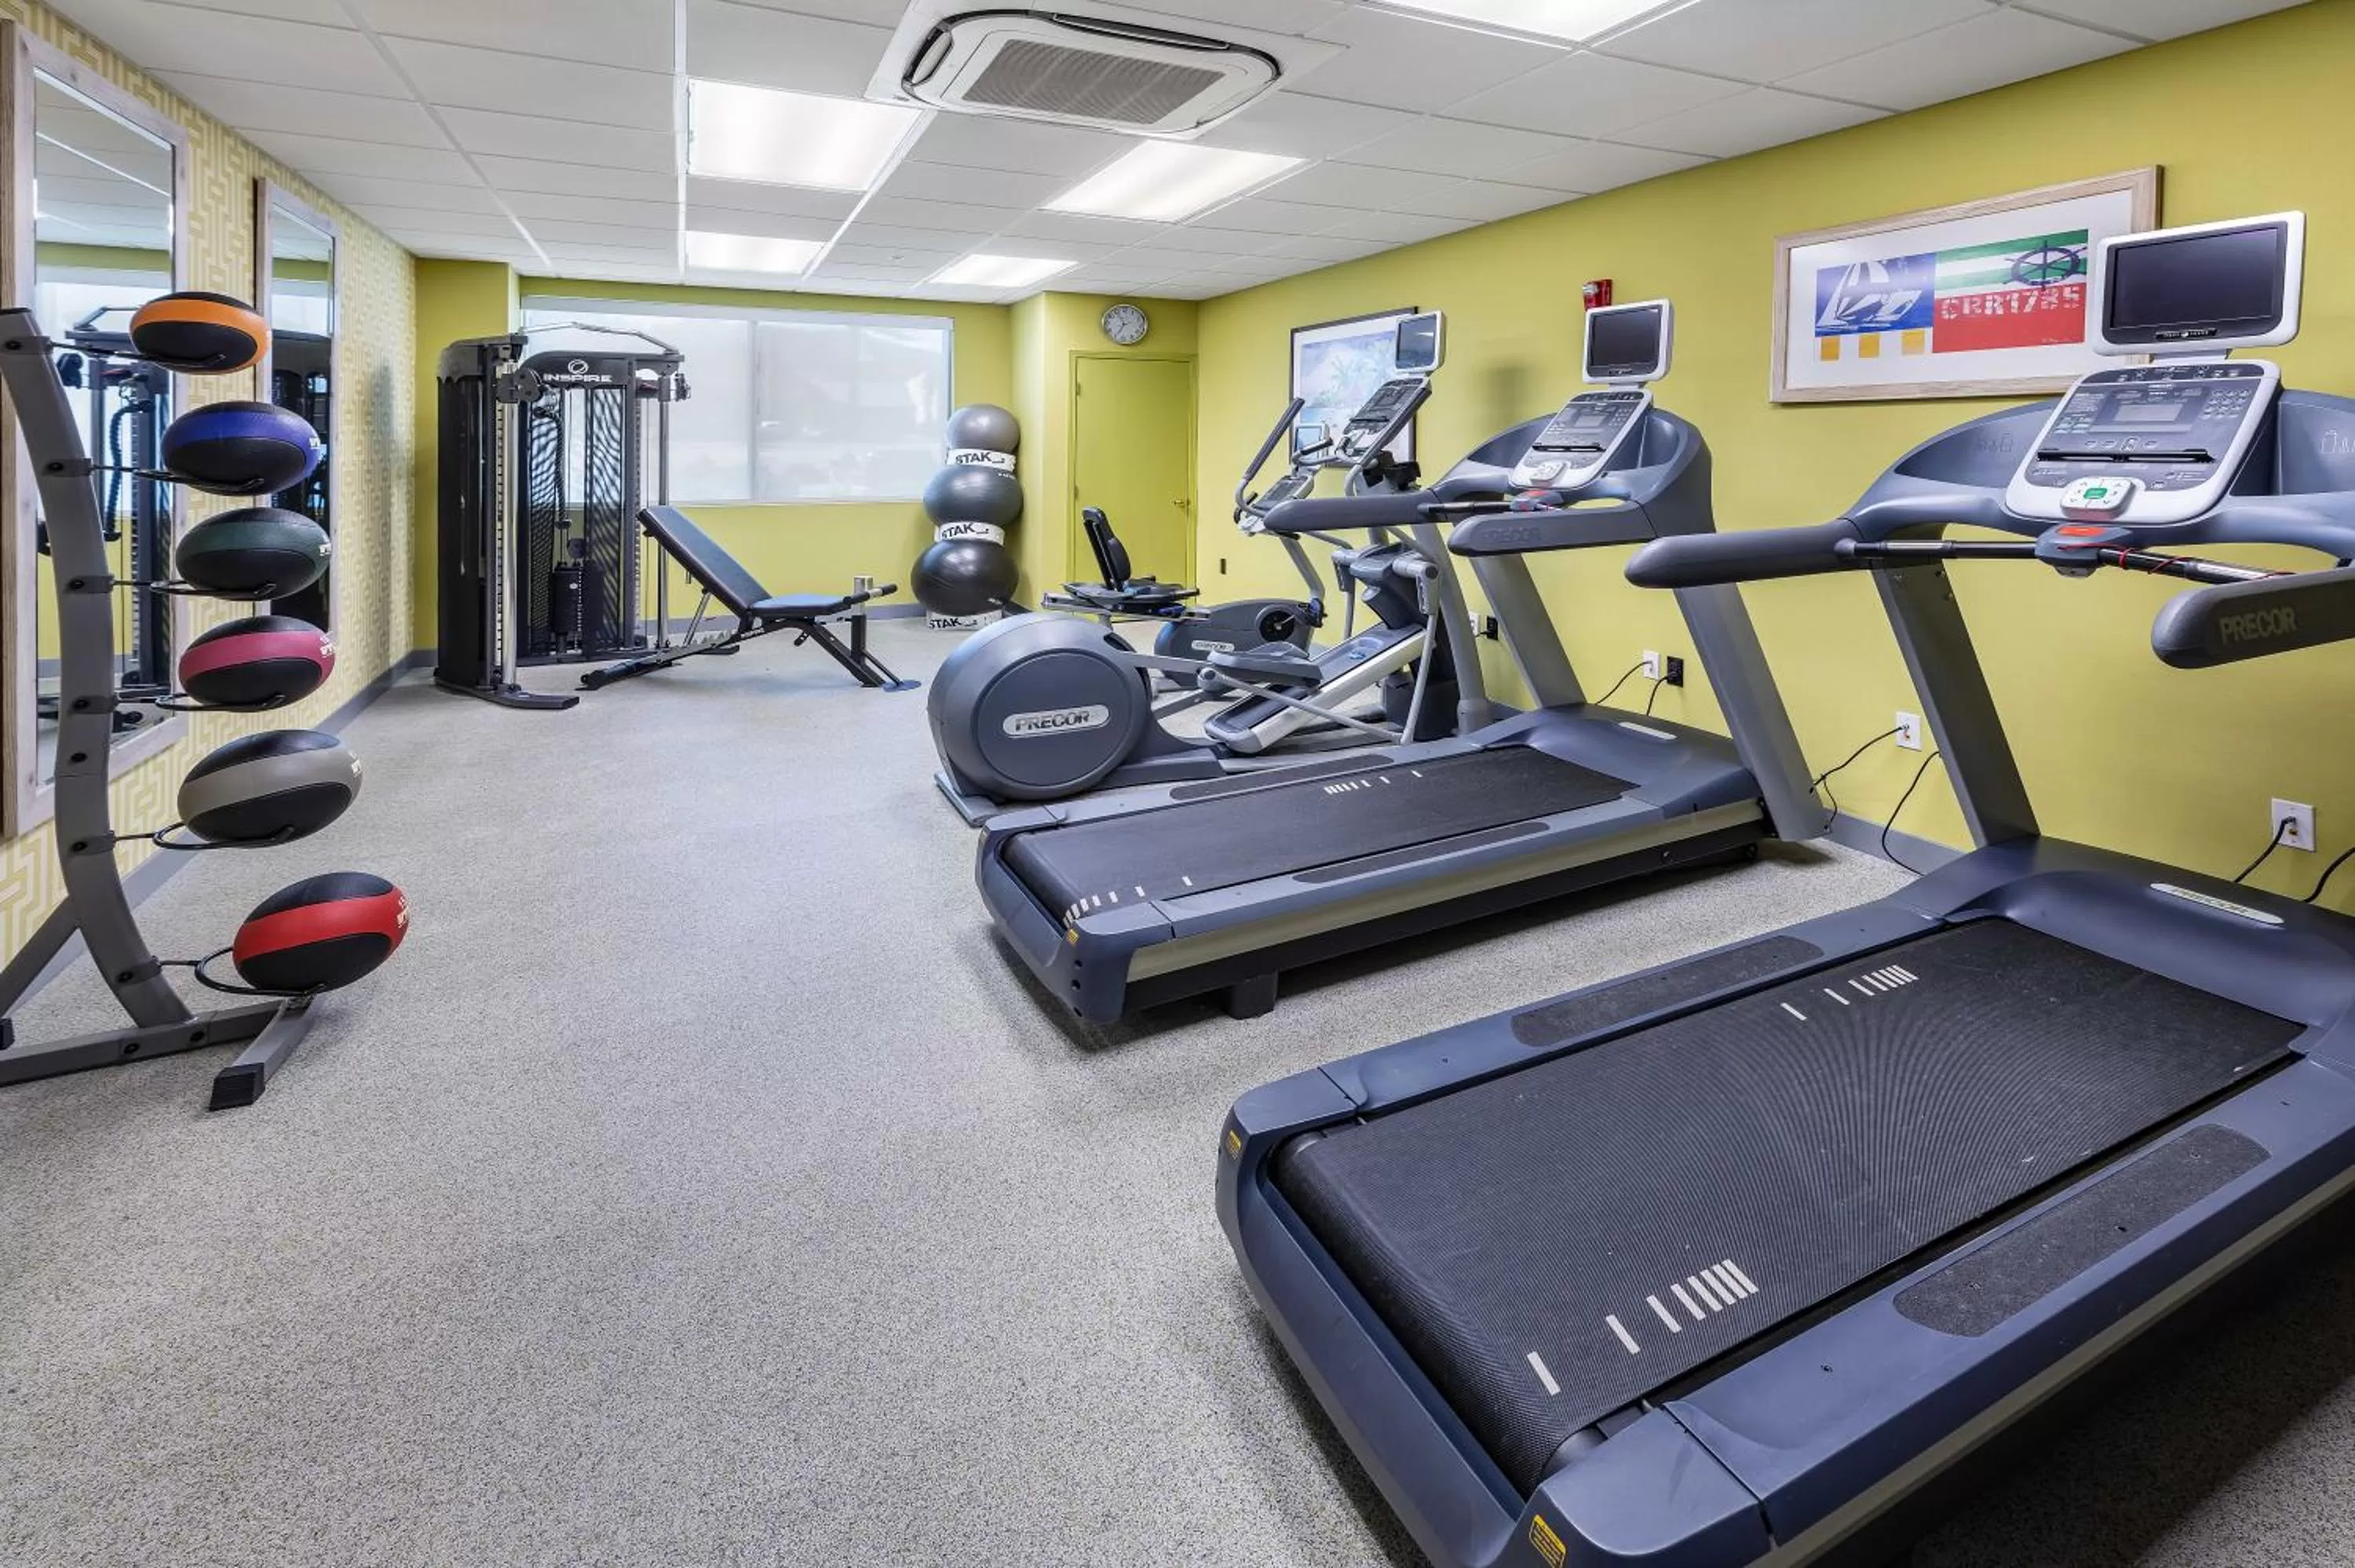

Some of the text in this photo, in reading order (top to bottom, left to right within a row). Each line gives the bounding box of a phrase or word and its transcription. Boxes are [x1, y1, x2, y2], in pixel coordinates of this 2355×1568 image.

[543, 373, 612, 382] INSPIRE
[955, 451, 992, 465] STAK
[929, 617, 962, 629] STAK
[2219, 606, 2297, 645] PRECOR
[1014, 710, 1090, 731] PRECOR
